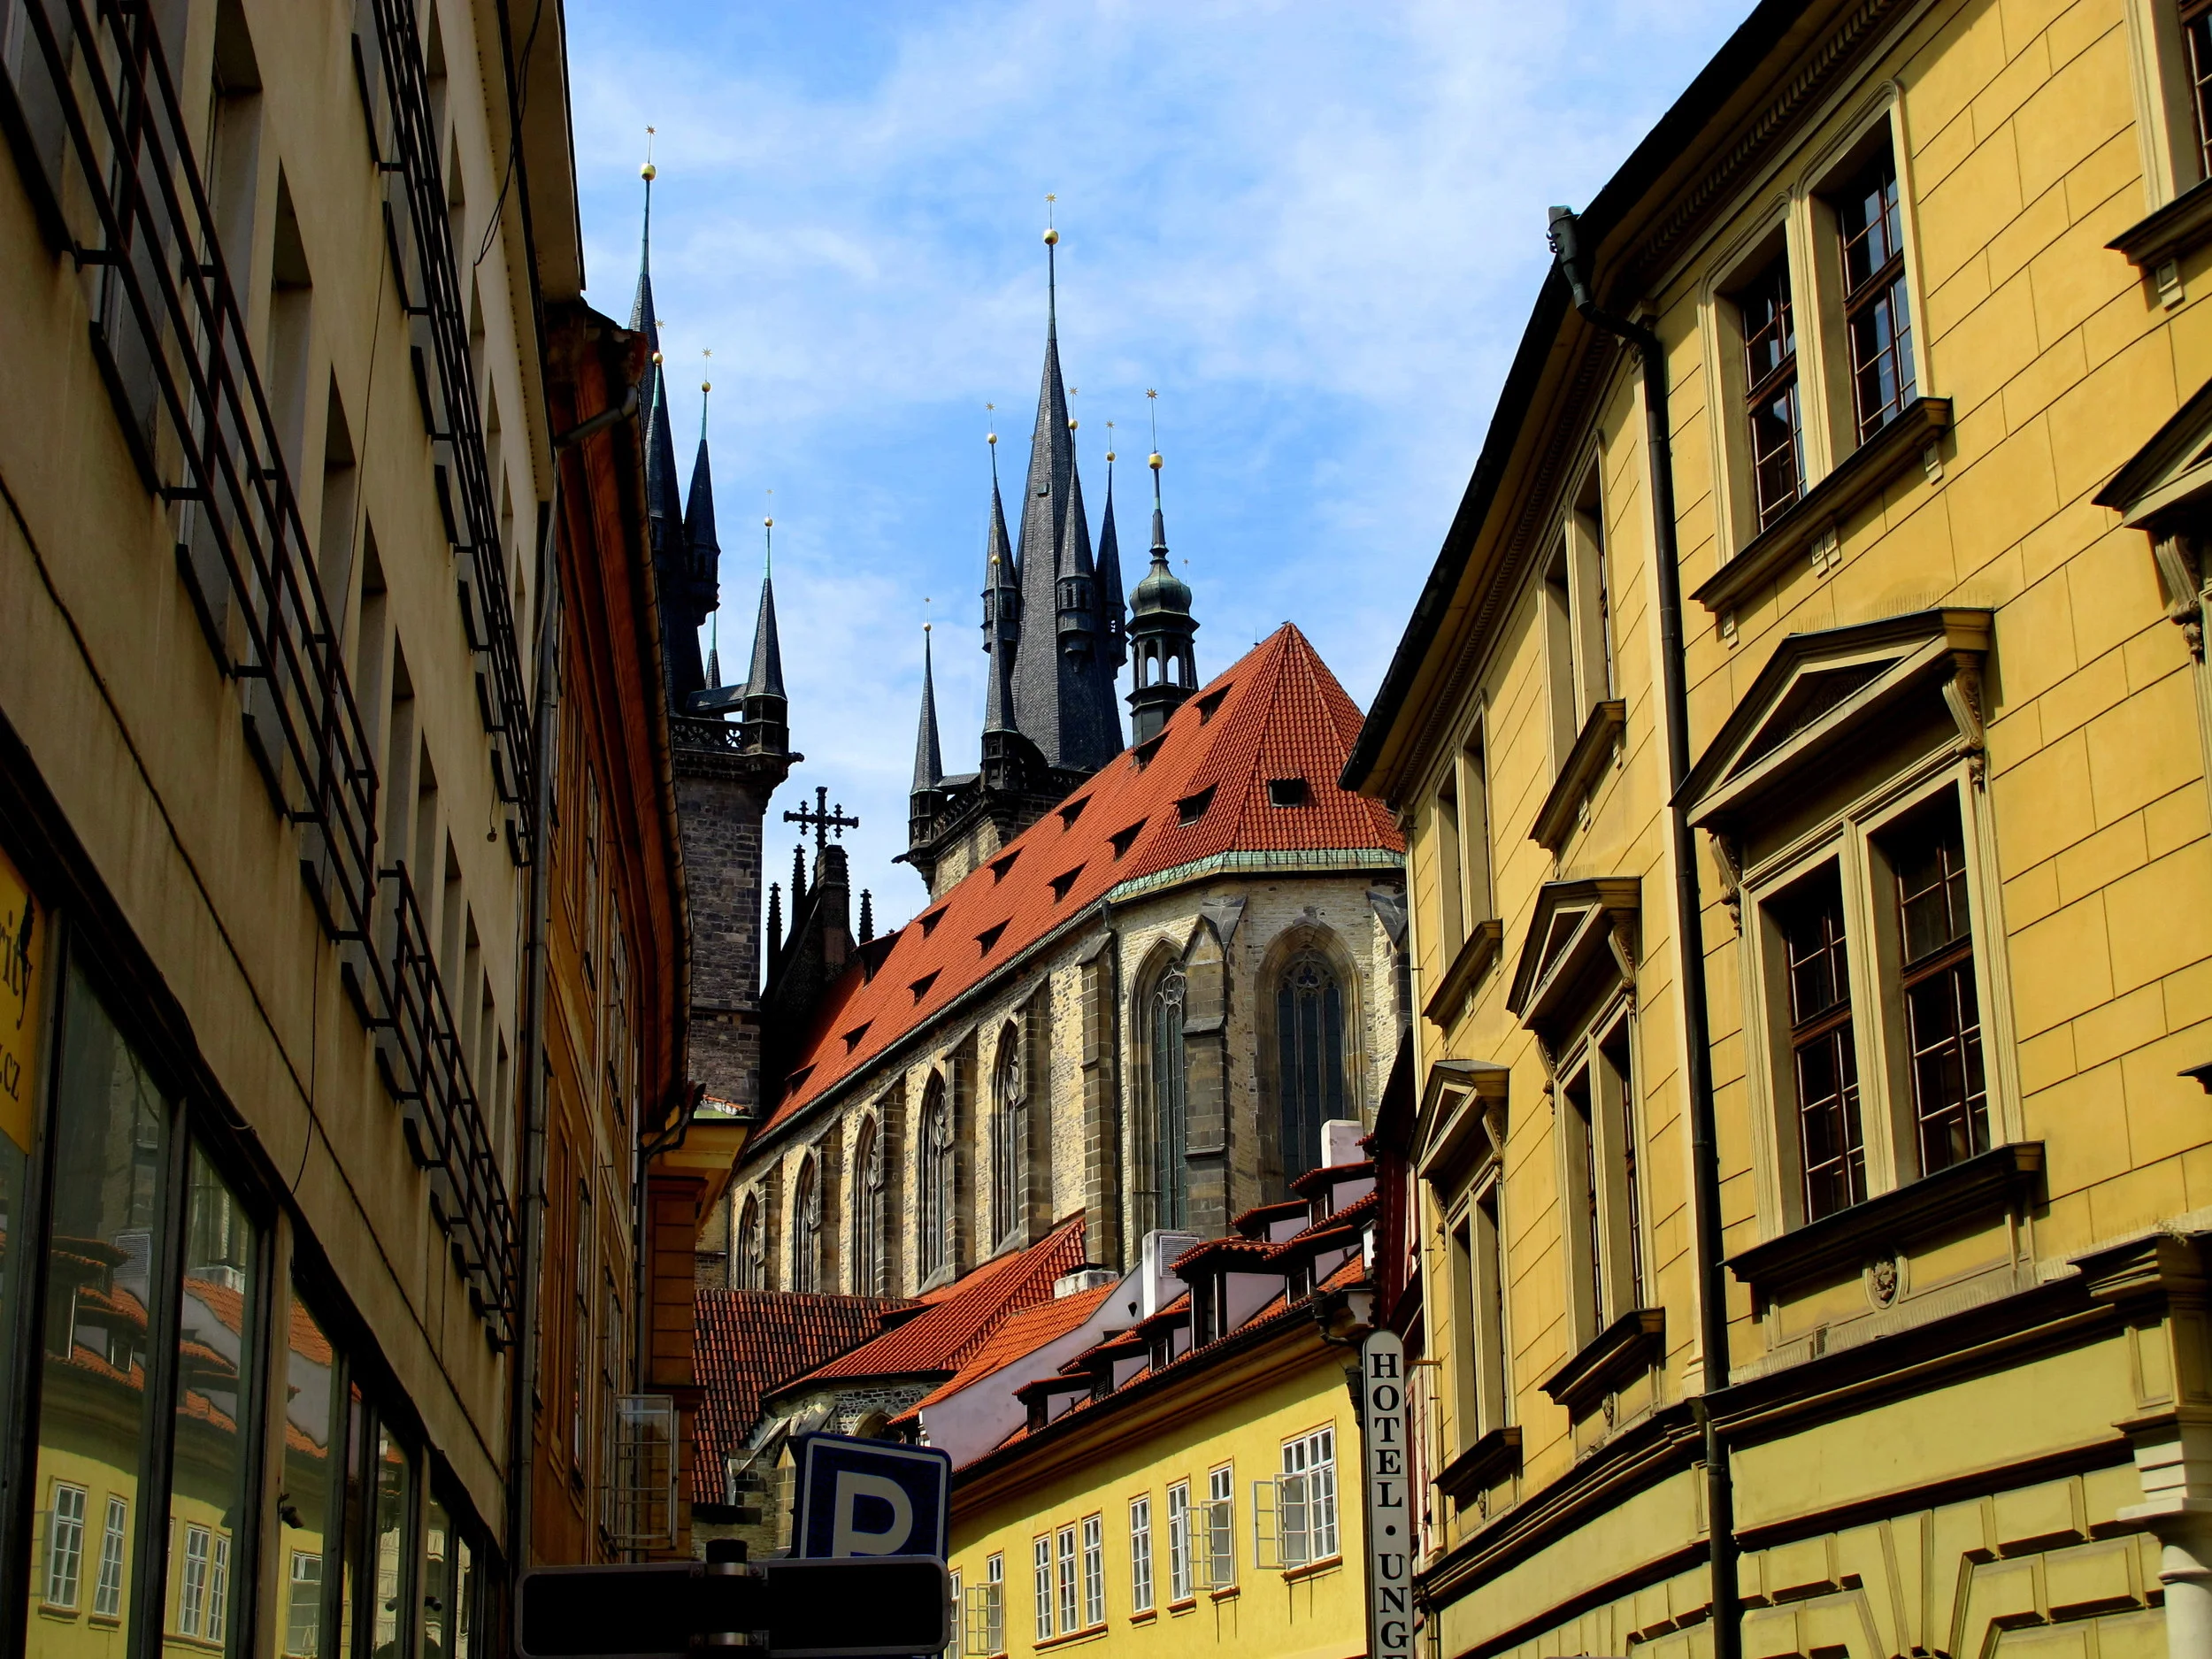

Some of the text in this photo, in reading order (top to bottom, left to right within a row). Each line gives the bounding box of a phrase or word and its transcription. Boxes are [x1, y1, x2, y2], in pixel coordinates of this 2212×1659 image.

[832, 1470, 913, 1557] P
[1371, 1353, 1409, 1659] HOTEL UNG
